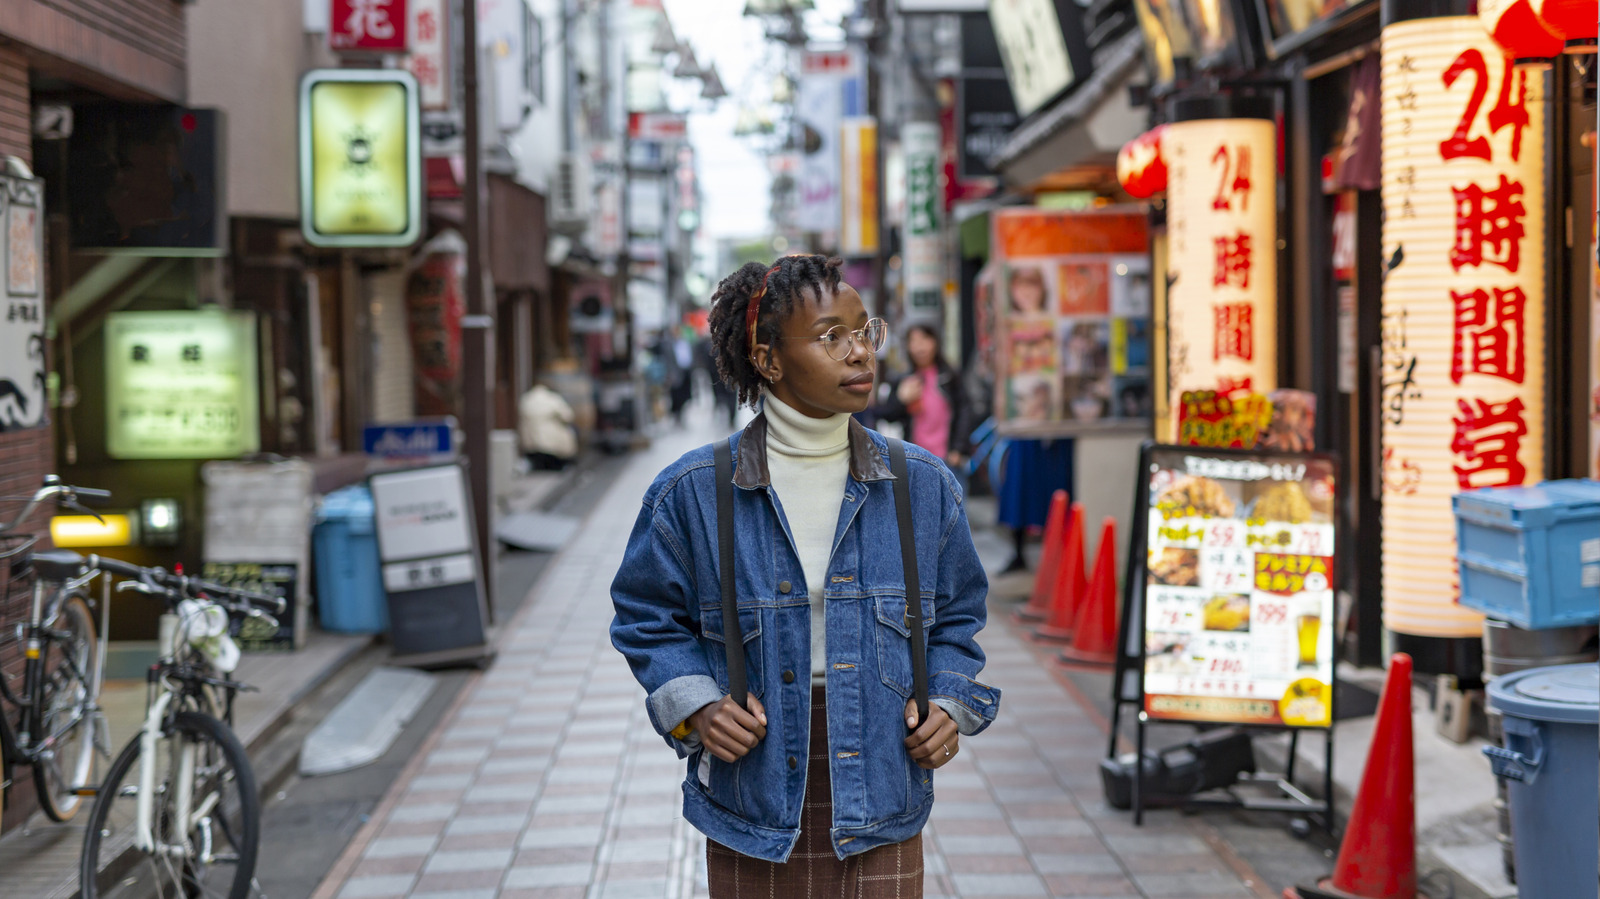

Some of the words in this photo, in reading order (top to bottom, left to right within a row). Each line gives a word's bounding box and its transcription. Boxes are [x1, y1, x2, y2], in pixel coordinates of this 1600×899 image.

[1438, 48, 1532, 490] 24時間営
[1255, 552, 1326, 576] プレミアム
